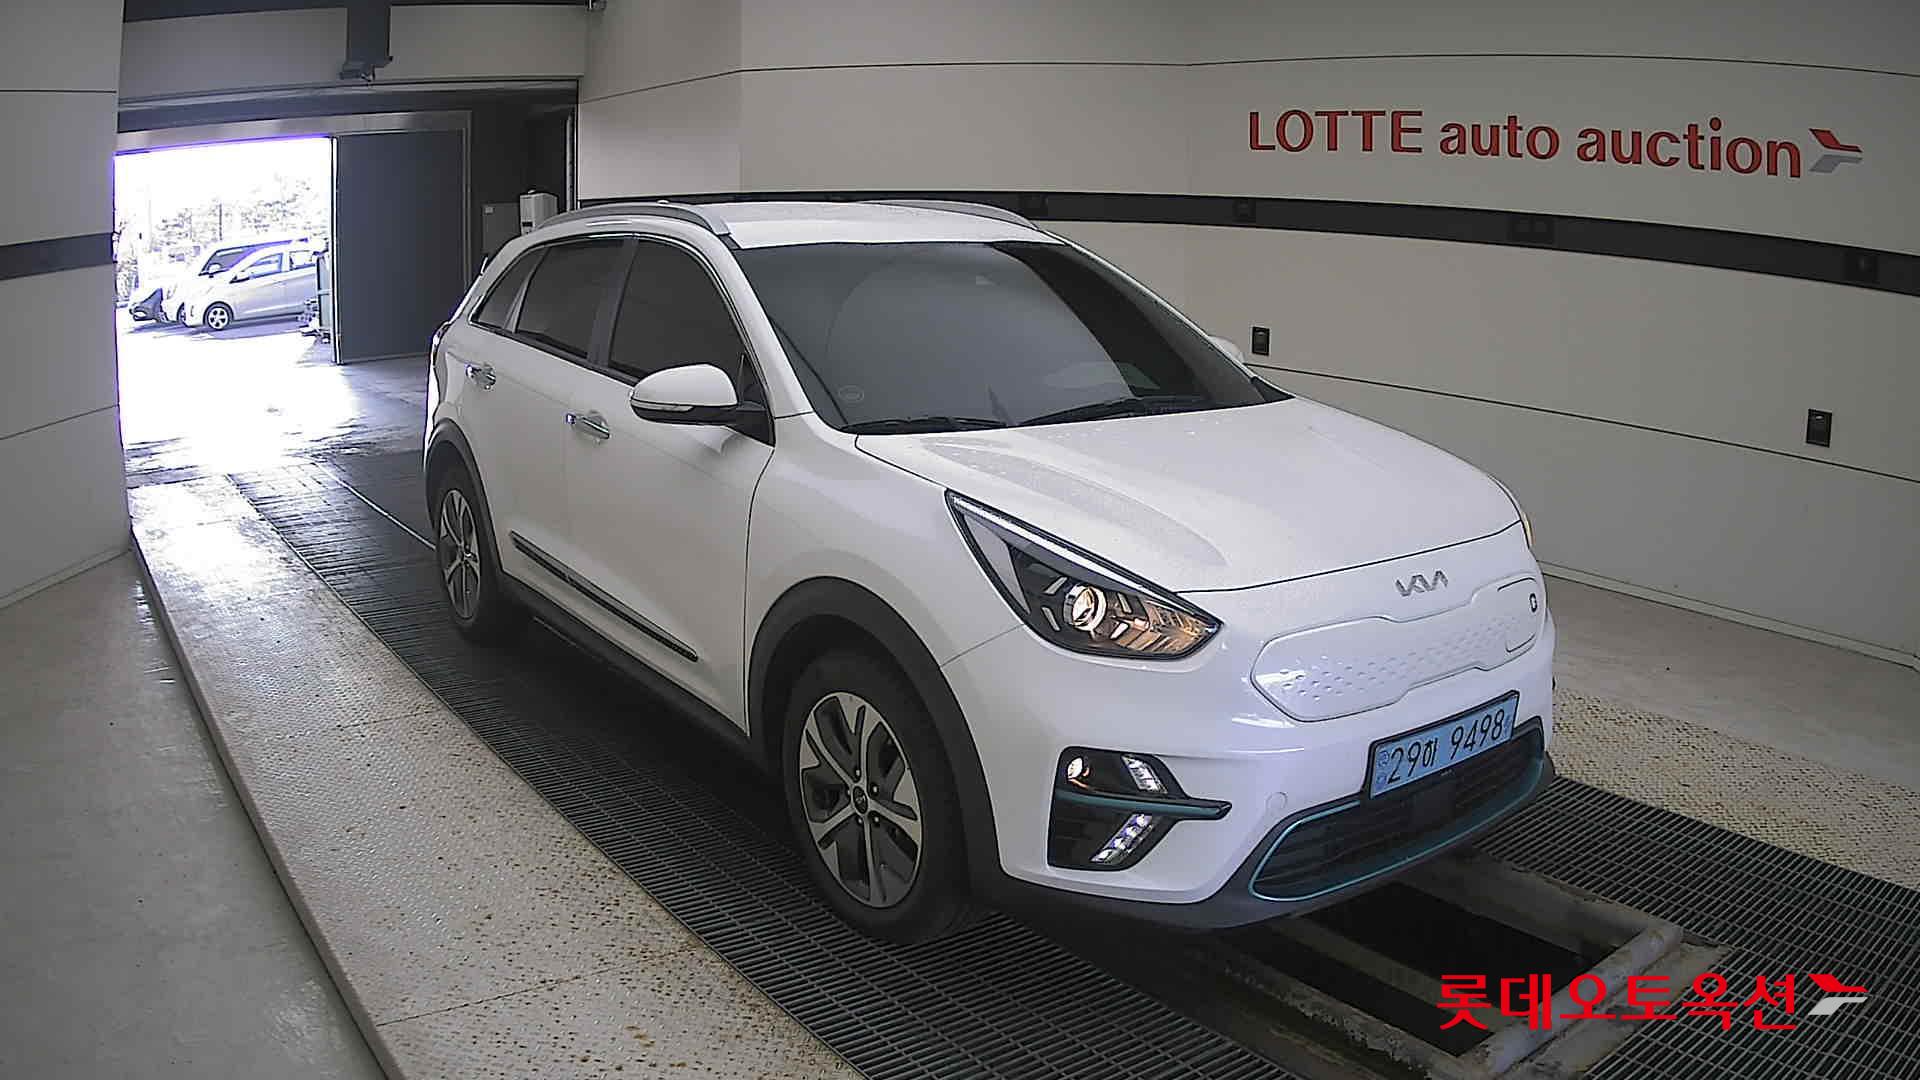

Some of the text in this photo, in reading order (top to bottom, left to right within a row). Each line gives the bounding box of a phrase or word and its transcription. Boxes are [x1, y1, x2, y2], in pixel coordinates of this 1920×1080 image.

[1249, 110, 1801, 179] LOTTE auto auction
[1450, 708, 1505, 760] 9498
